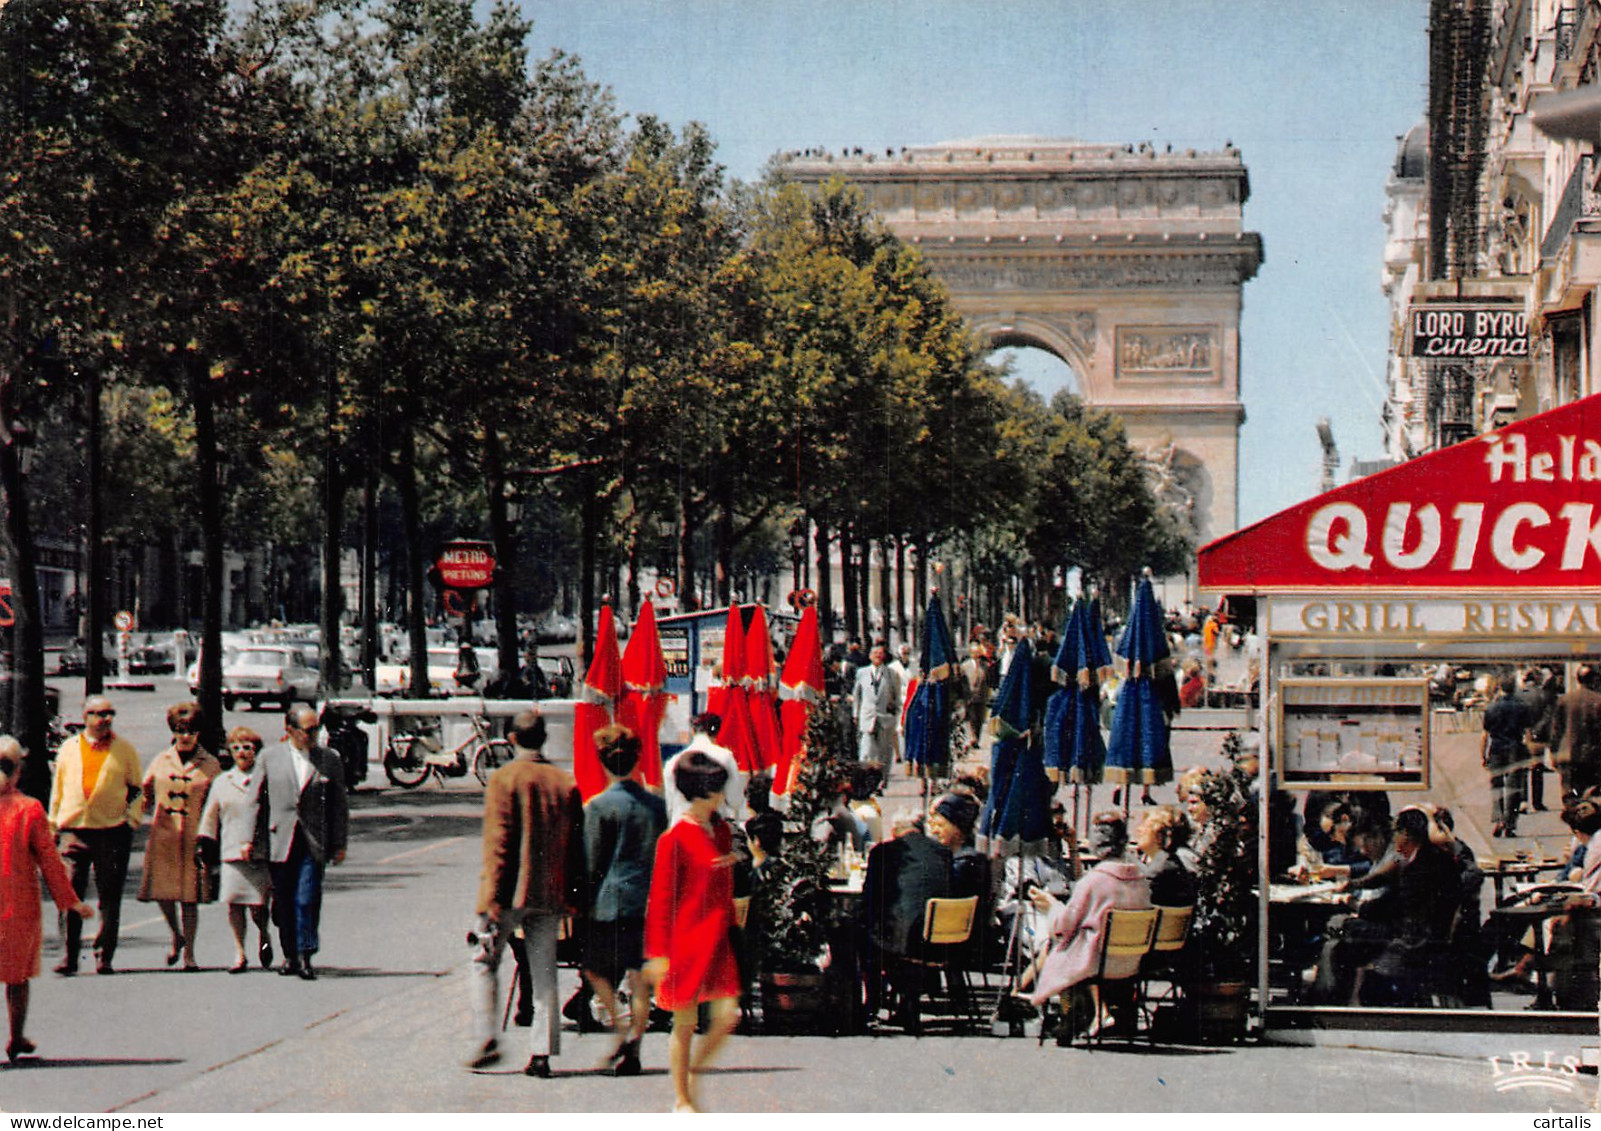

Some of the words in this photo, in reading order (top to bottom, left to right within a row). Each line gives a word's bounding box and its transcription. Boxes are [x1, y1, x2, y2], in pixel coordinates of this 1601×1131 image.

[1415, 311, 1465, 336] LORD
[1475, 311, 1528, 337] BYRO
[1425, 337, 1528, 355] cinema
[1306, 501, 1600, 571] QUICK
[443, 551, 487, 564] METRO
[1300, 602, 1426, 633] GRILL
